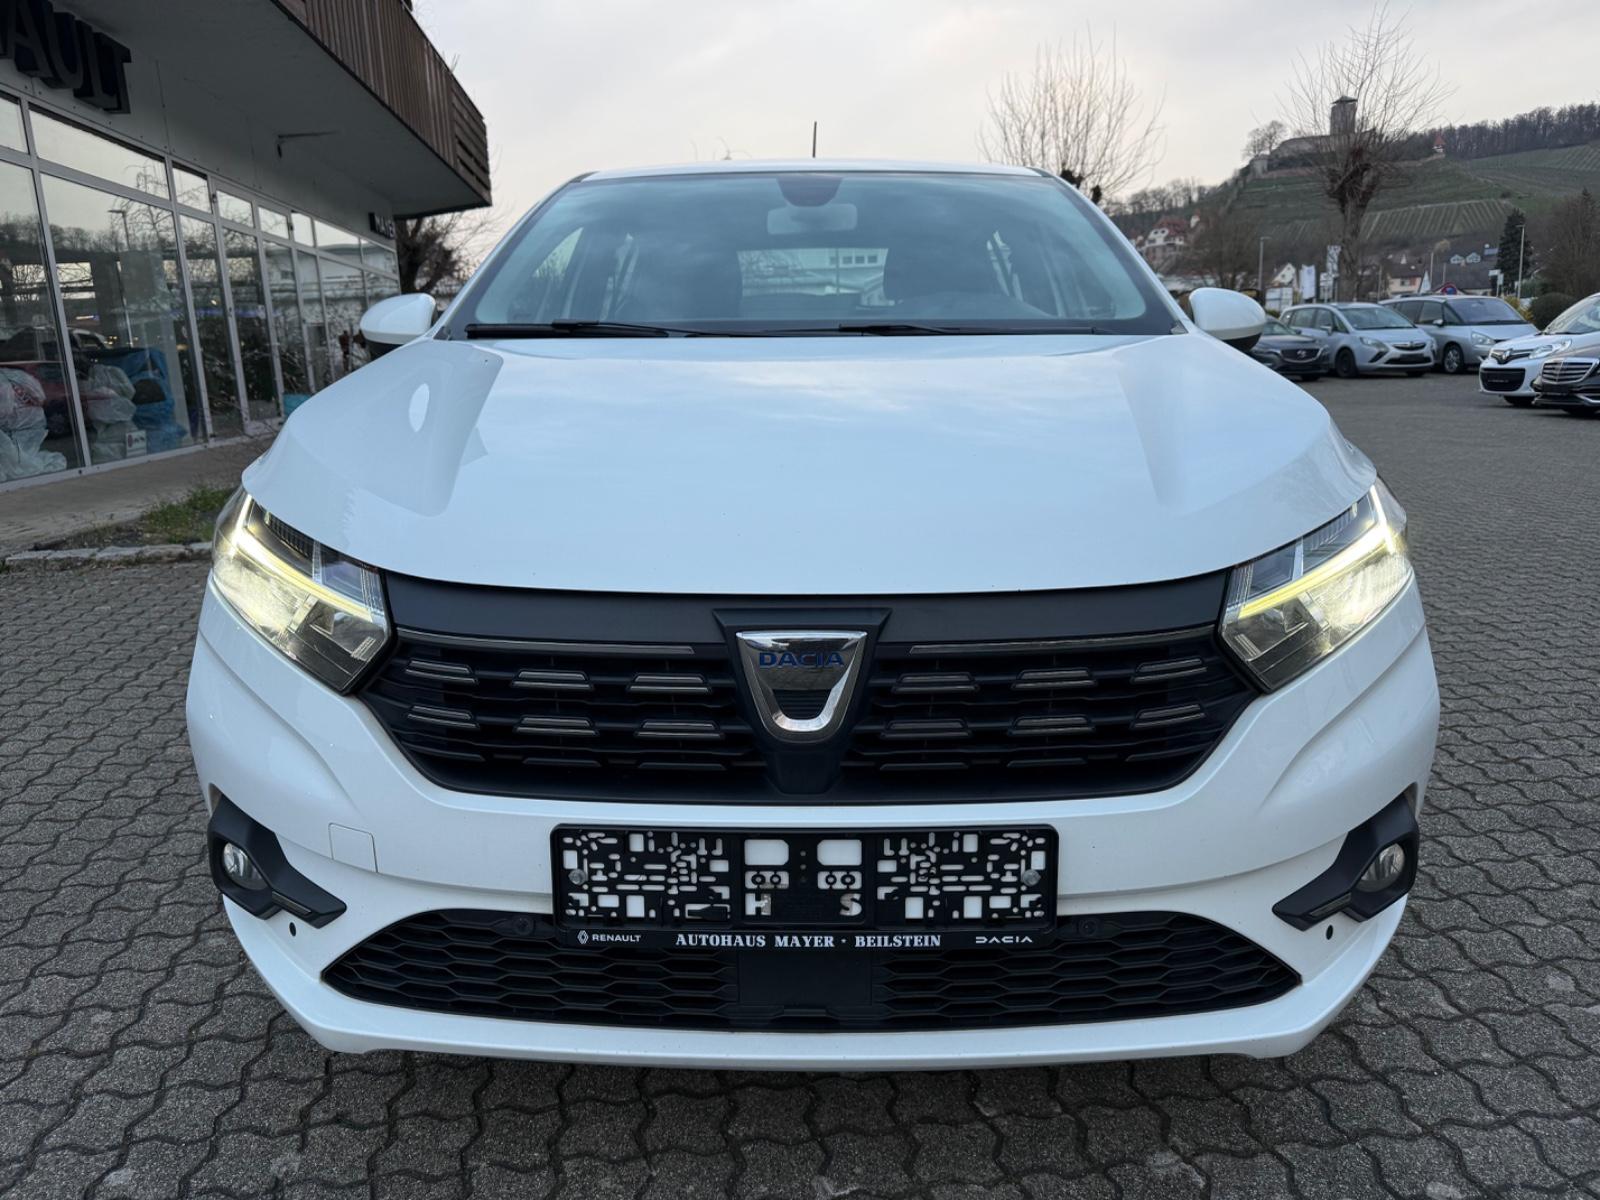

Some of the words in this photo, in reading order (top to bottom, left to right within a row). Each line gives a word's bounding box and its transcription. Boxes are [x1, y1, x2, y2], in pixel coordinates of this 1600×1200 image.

[759, 652, 845, 667] DACIA
[591, 933, 642, 943] RENAULT
[675, 933, 766, 948] AUTOHAUS
[774, 935, 835, 948] MAYER
[854, 934, 942, 948] BEILSTEIN
[975, 935, 1033, 944] DACIA
